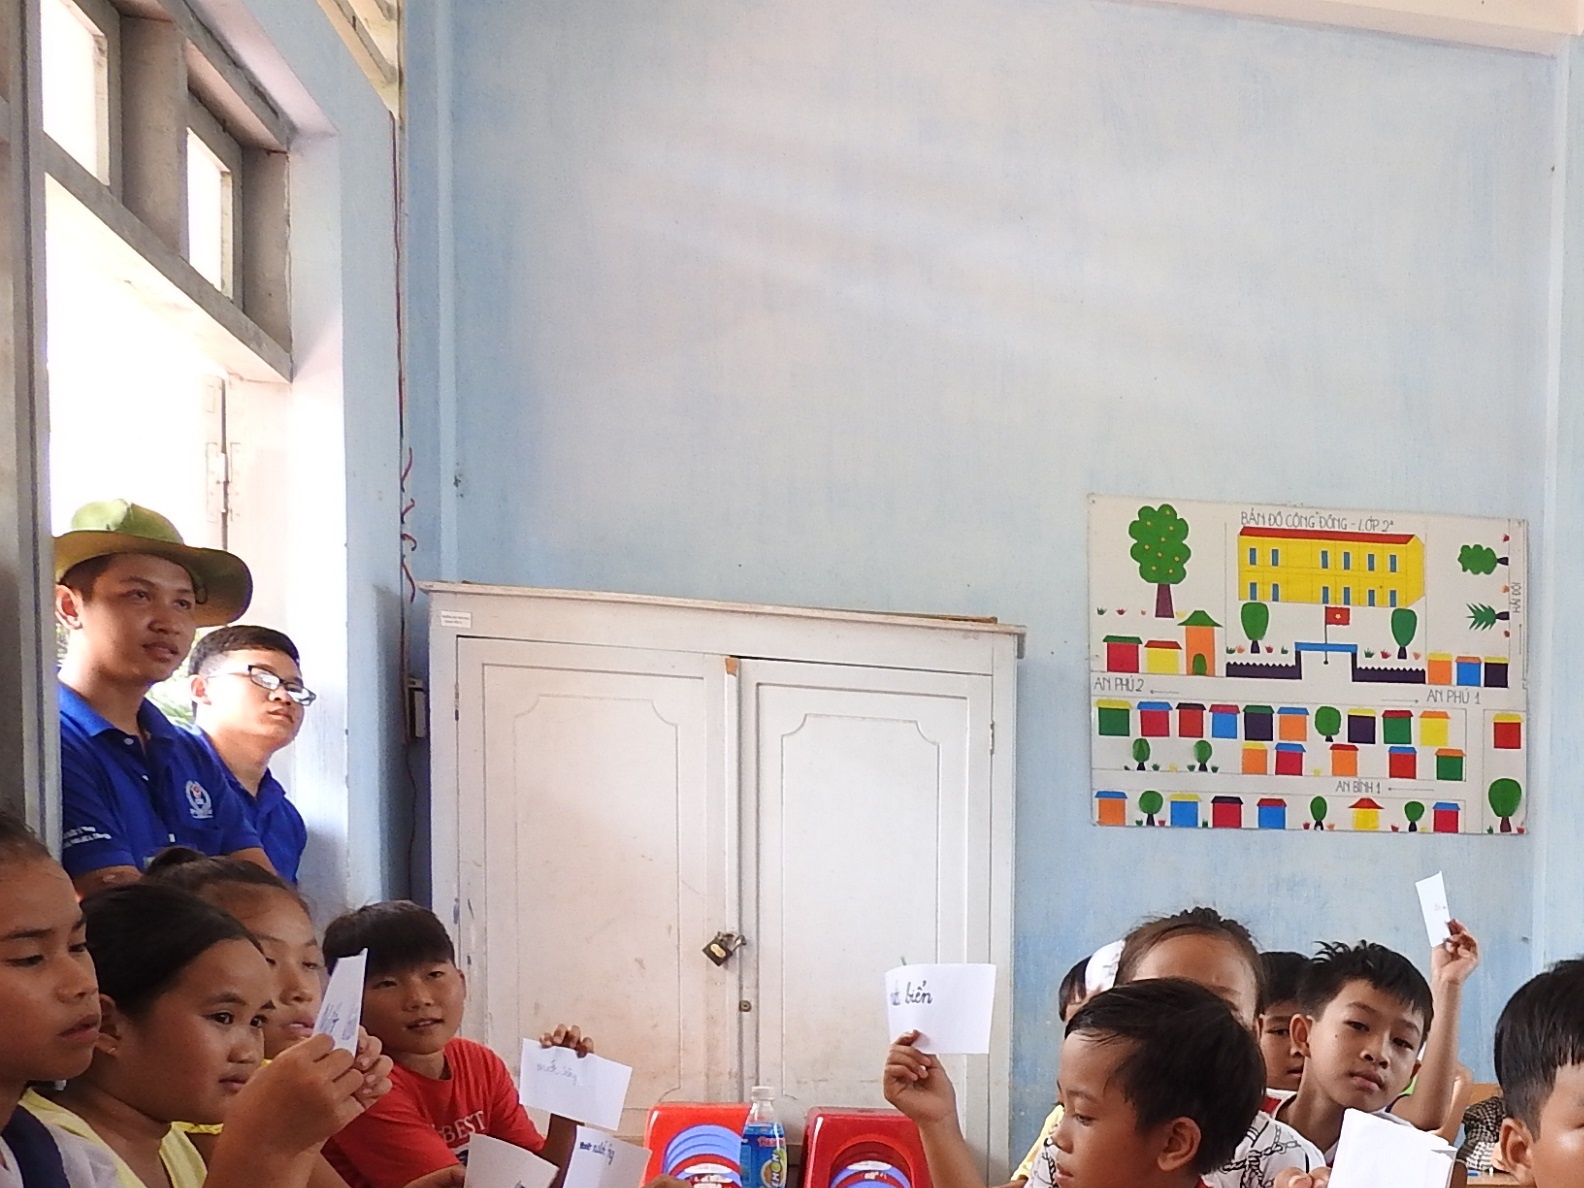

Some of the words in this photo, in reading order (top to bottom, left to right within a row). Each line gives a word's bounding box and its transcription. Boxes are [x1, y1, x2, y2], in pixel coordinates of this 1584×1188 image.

[1094, 677, 1111, 691] AN
[1135, 678, 1145, 692] 2
[1426, 689, 1443, 703] AN
[1474, 691, 1481, 705] 1
[1335, 780, 1350, 792] AN
[440, 1109, 487, 1144] BEST
